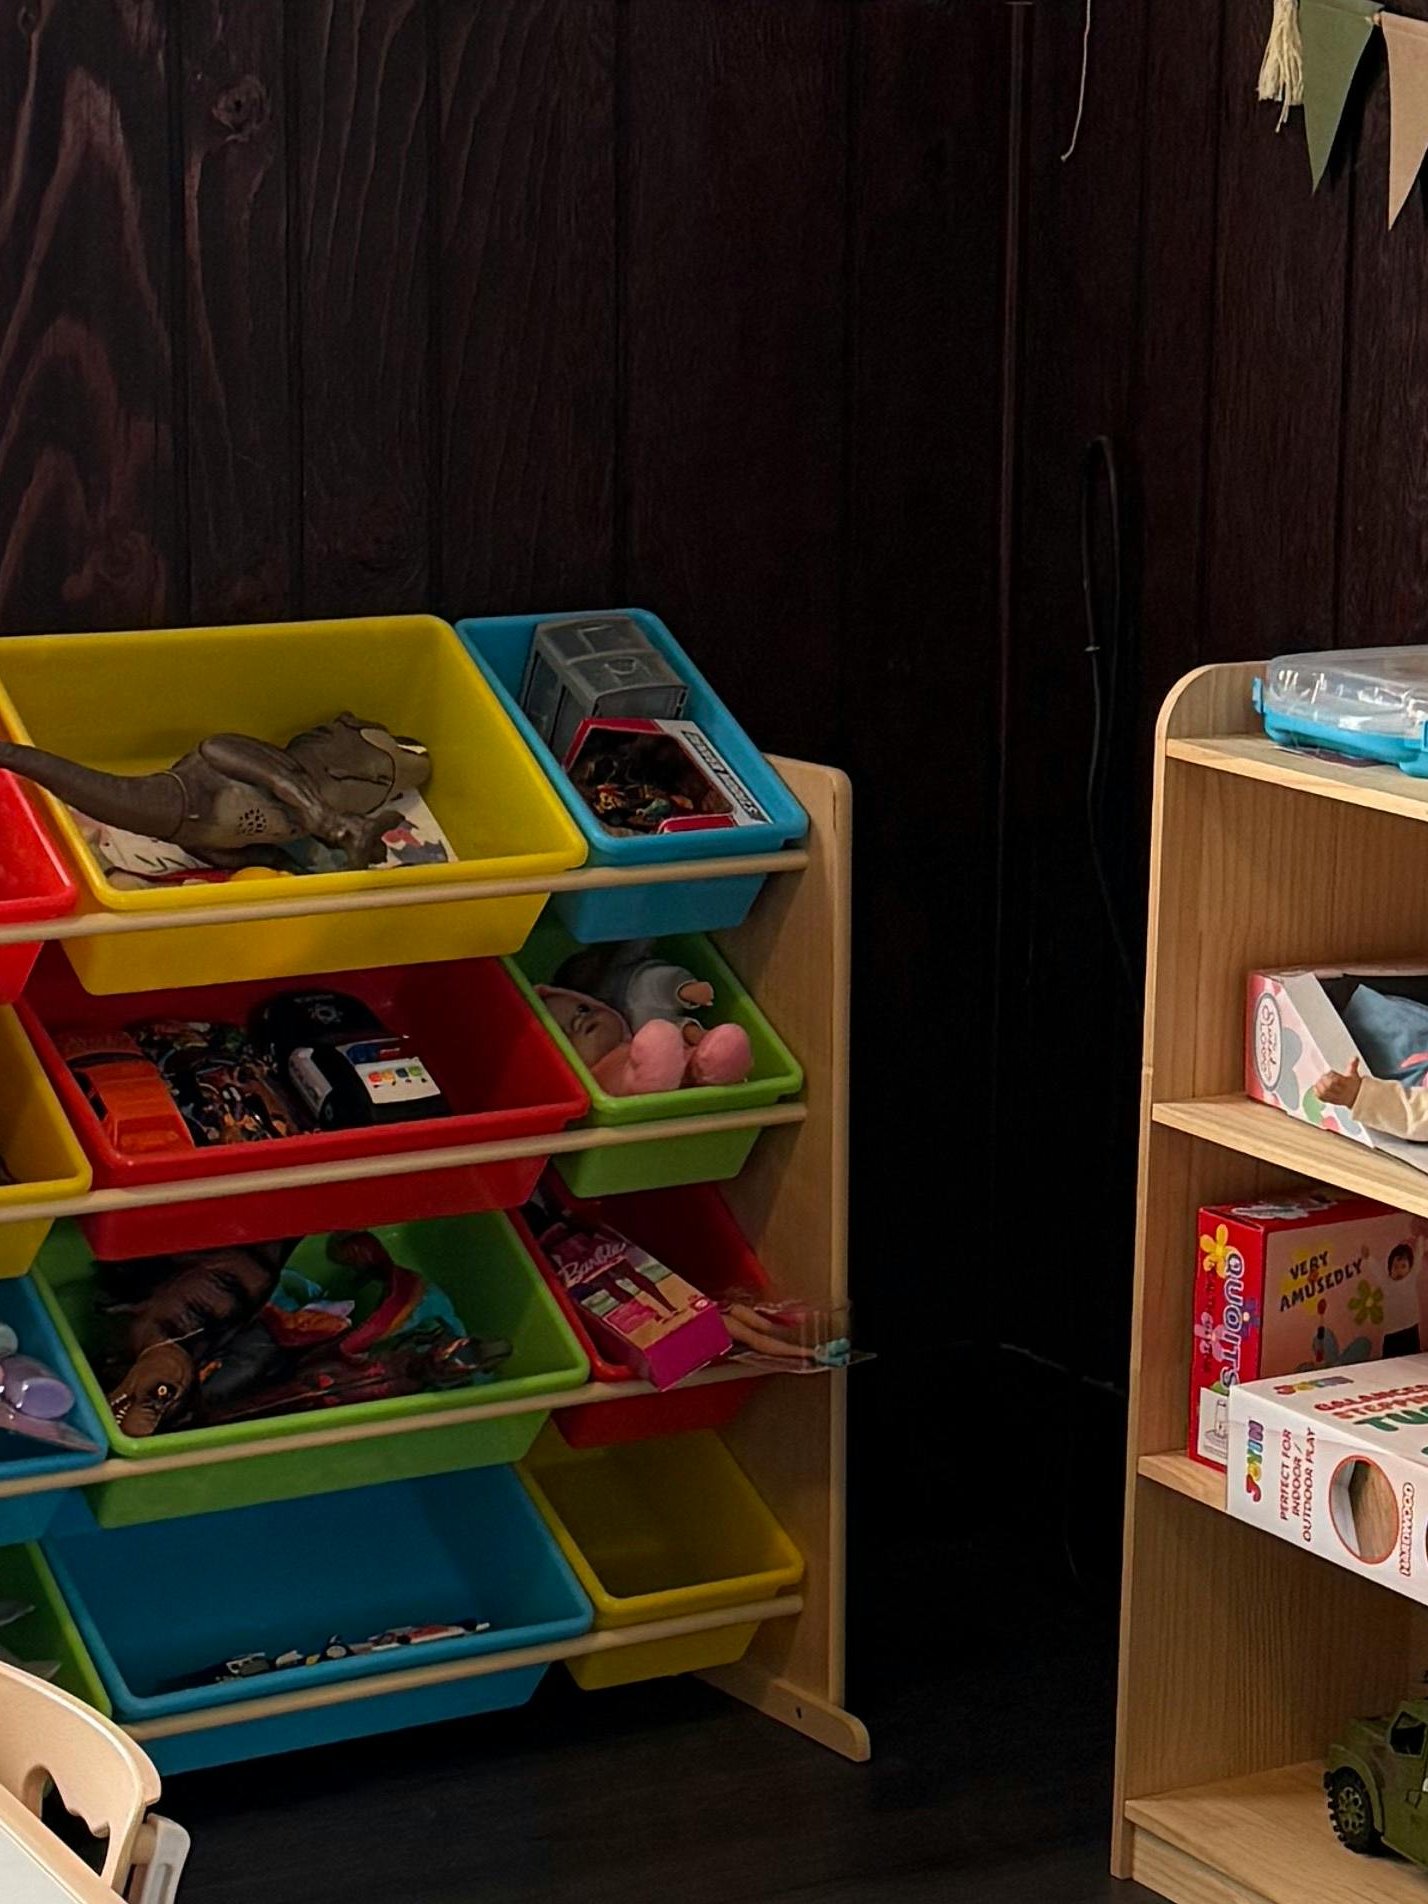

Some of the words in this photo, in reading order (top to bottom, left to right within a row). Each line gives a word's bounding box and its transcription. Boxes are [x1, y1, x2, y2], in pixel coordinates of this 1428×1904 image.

[1280, 1258, 1363, 1312] AMUSEDLY
[1290, 1251, 1328, 1280] VERY
[1221, 1250, 1244, 1390] QUOITS
[1282, 1429, 1292, 1459] FOR
[1304, 1427, 1316, 1465] PLAY
[1292, 1457, 1302, 1517] INDOOR
[1303, 1466, 1313, 1543] OUTDOOR
[1399, 1482, 1414, 1577] HARDWOOD
